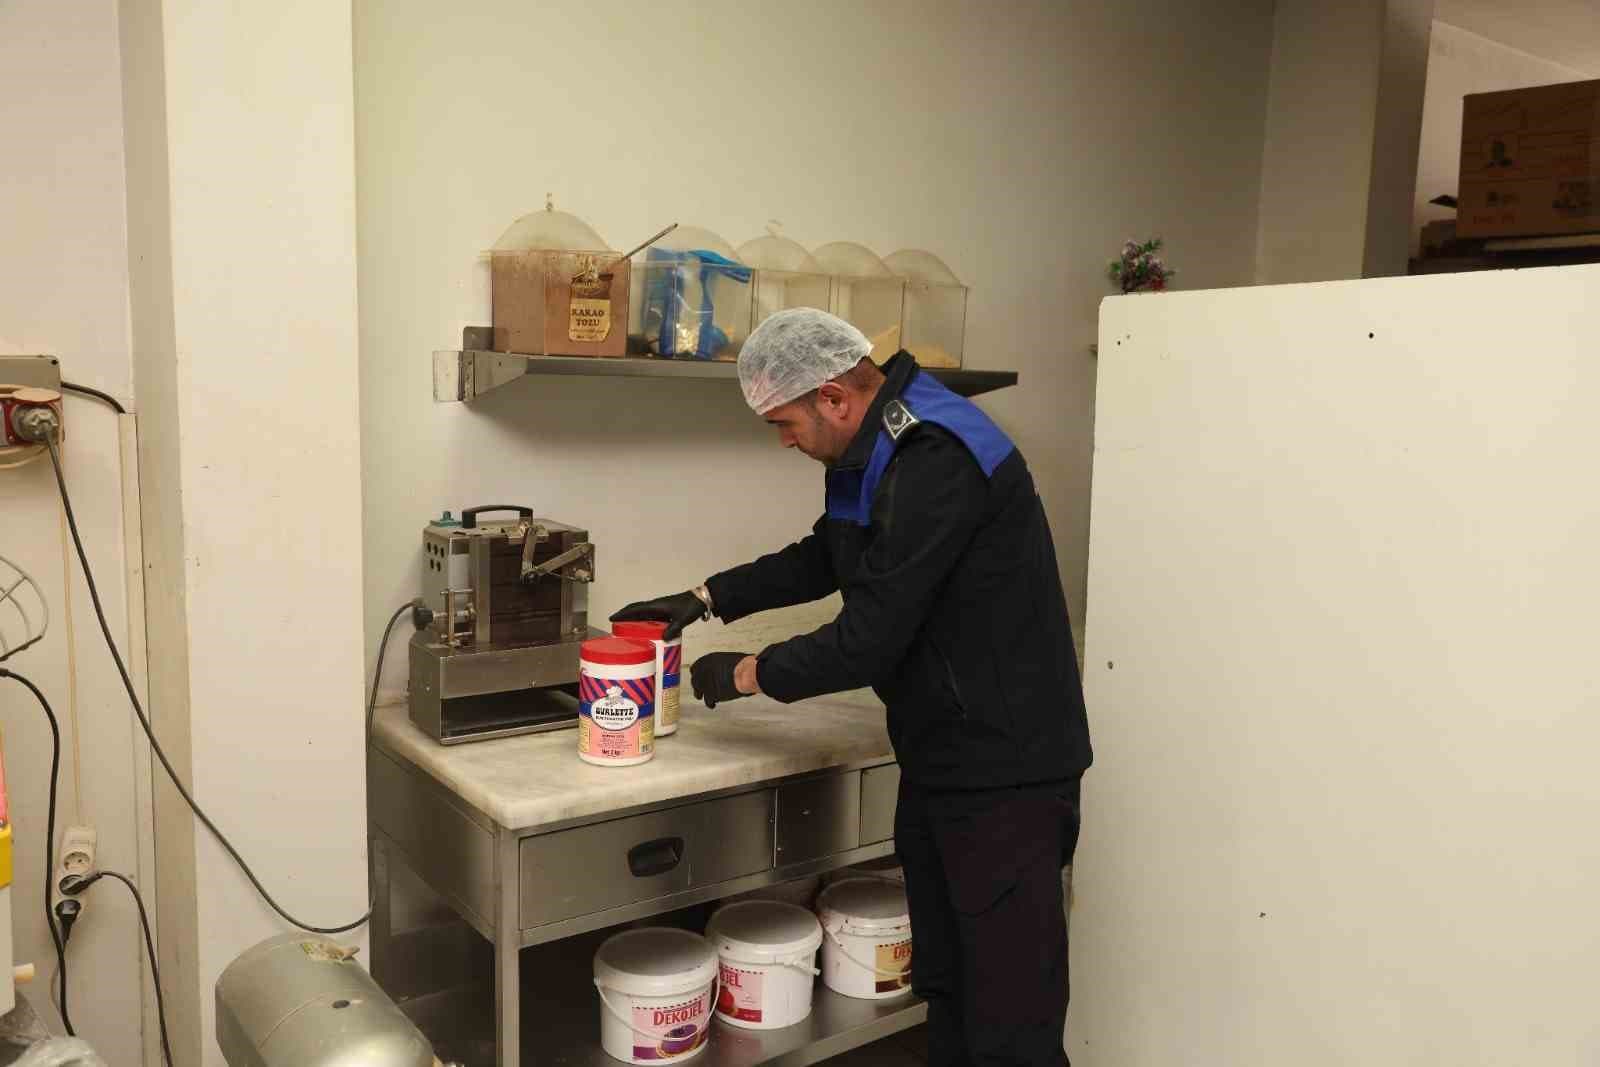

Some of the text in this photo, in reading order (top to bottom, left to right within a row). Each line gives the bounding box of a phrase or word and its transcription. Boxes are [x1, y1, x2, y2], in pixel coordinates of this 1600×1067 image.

[571, 309, 605, 317] KAKAO
[576, 319, 600, 327] TOZU
[653, 1000, 704, 1026] DEKOJEL
